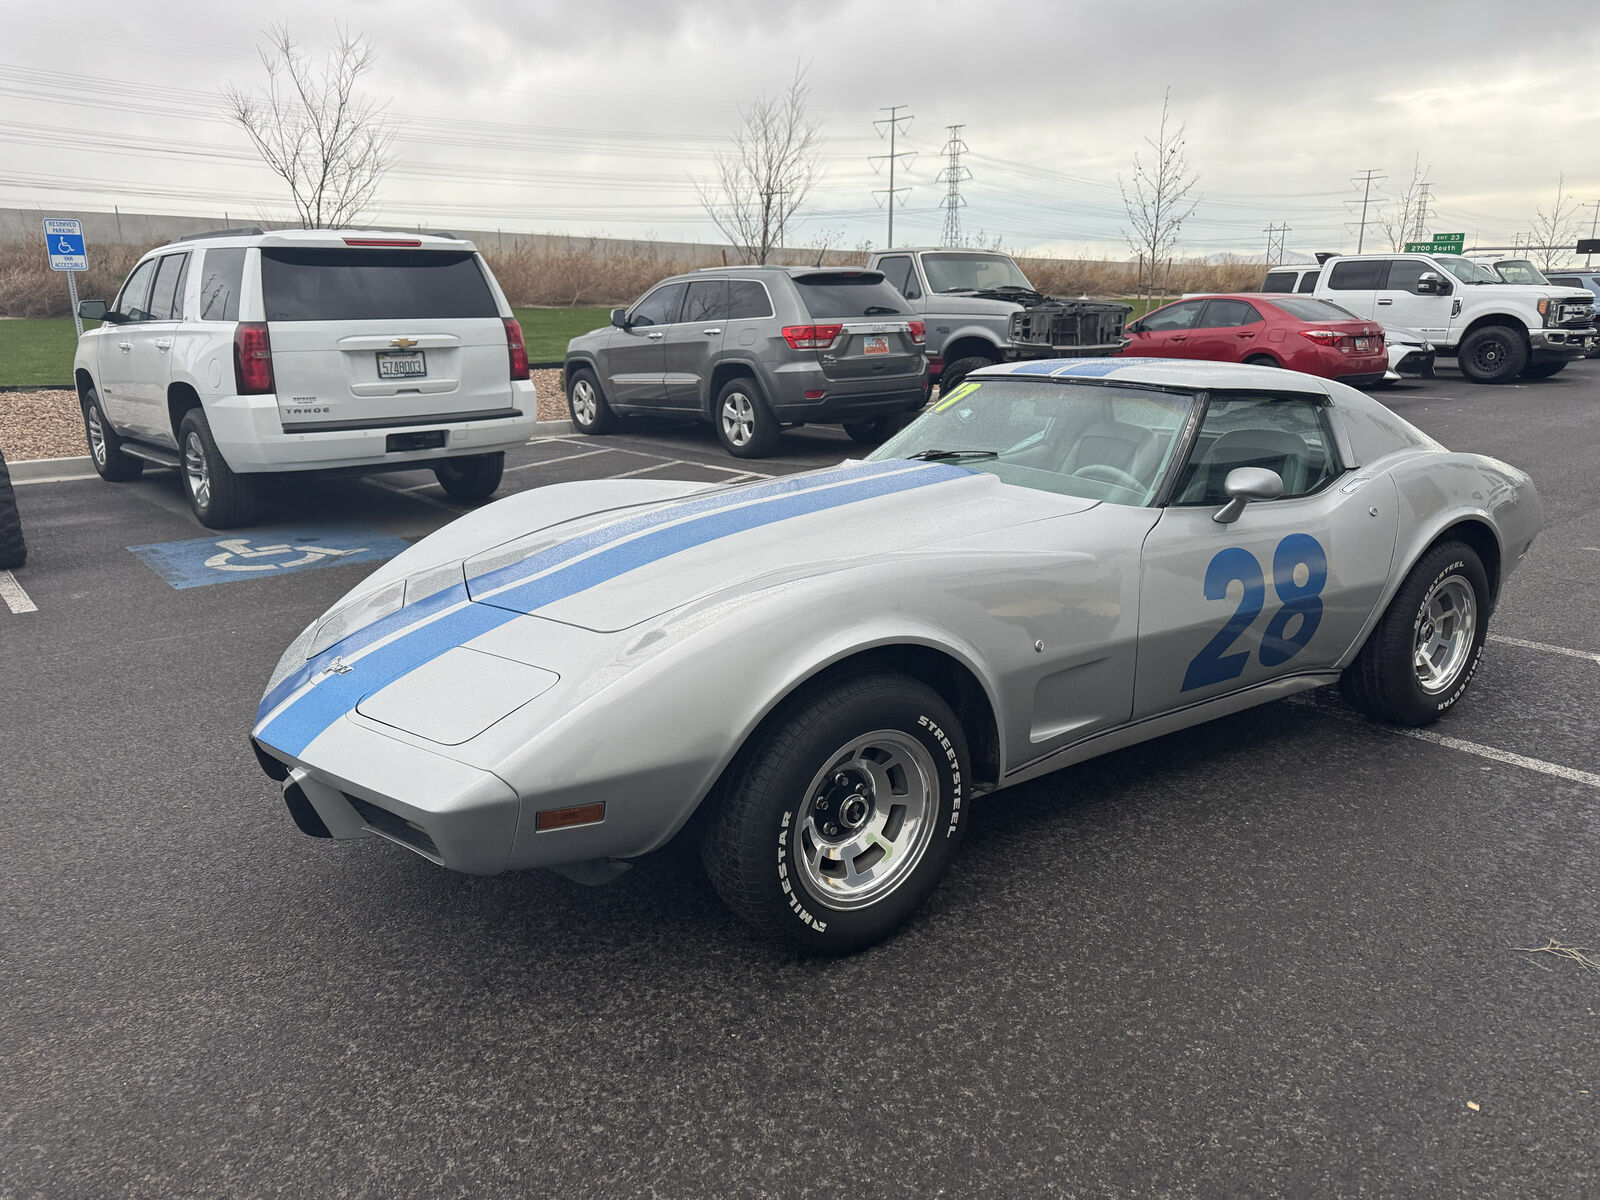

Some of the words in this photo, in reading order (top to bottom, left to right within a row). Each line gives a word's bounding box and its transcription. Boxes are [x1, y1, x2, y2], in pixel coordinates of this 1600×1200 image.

[1180, 533, 1327, 693] 28
[918, 715, 962, 838] STREETSTEEL
[778, 811, 813, 925] MILESTAR
